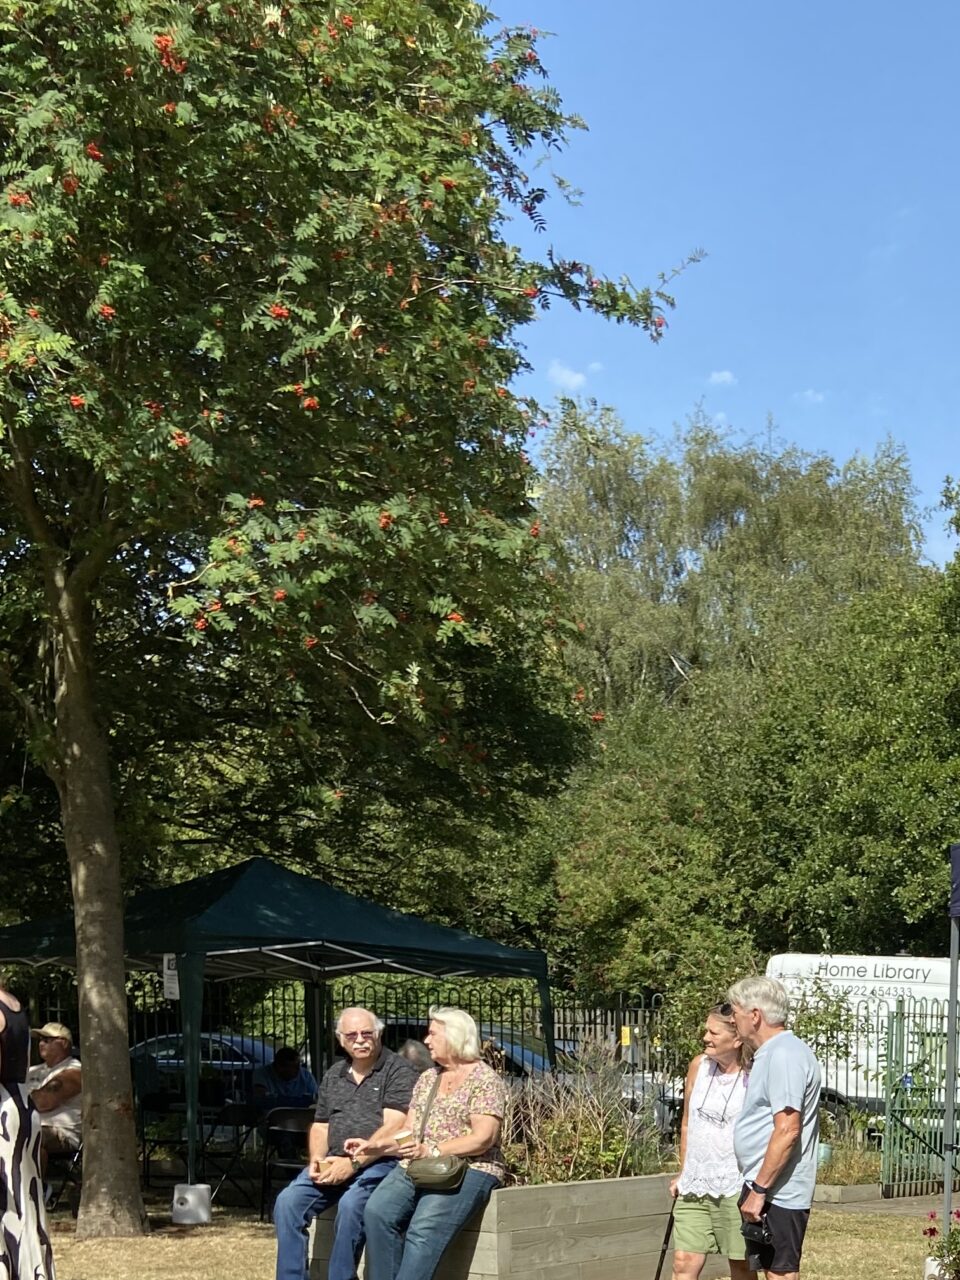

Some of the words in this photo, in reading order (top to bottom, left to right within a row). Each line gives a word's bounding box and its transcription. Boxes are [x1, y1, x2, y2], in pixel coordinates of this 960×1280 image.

[818, 962, 868, 978] Home
[873, 963, 931, 983] Library
[832, 984, 867, 996] 01922
[870, 986, 913, 998] 654333
